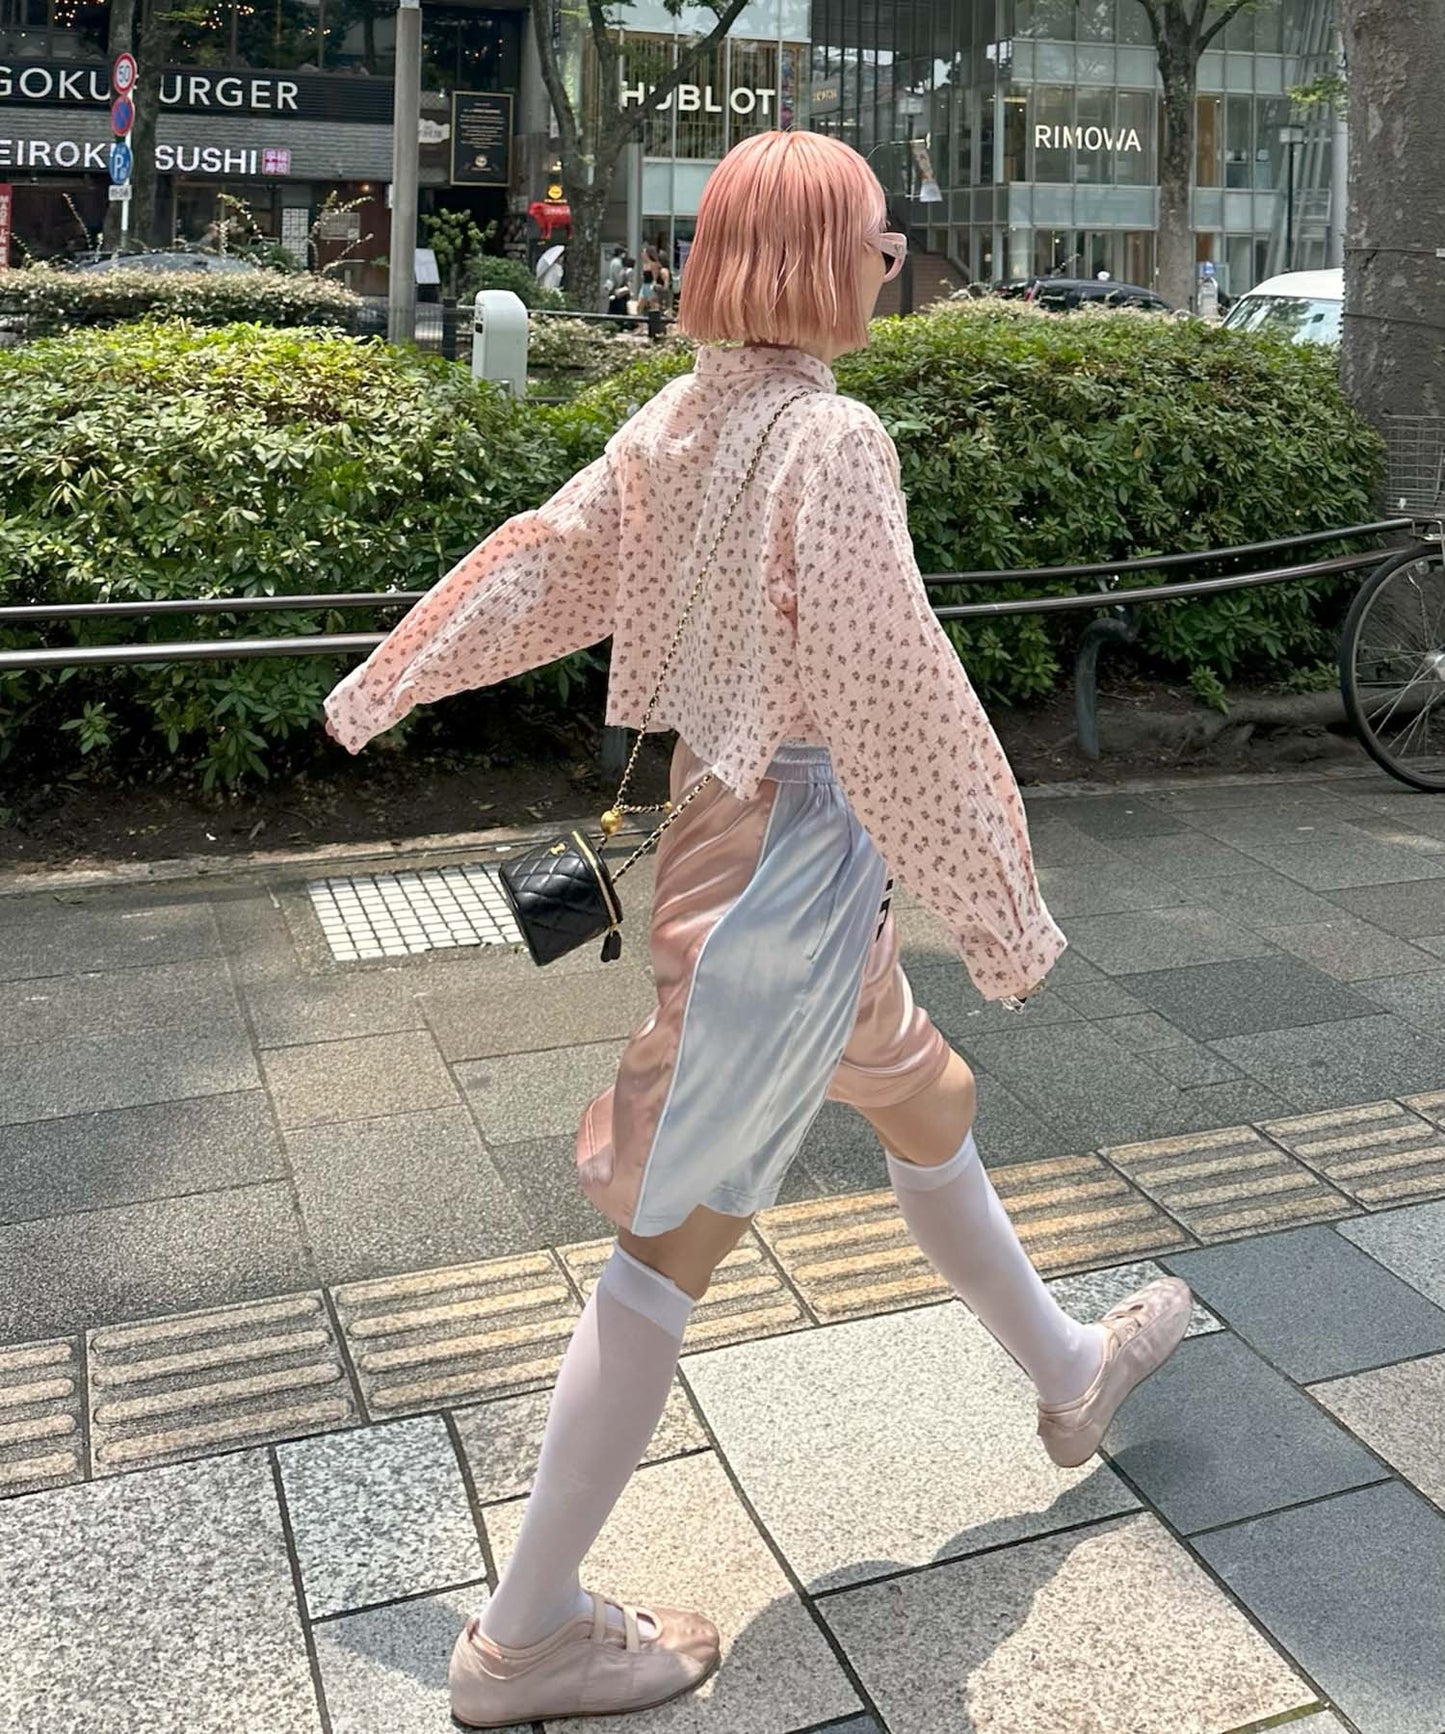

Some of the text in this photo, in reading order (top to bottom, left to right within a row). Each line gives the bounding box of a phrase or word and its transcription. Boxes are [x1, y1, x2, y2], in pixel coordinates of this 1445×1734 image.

[159, 75, 298, 110] URGER
[1035, 125, 1142, 152] RIMOWA
[0, 139, 117, 168] EIROK
[155, 145, 257, 174] SUSHI
[114, 154, 123, 178] P
